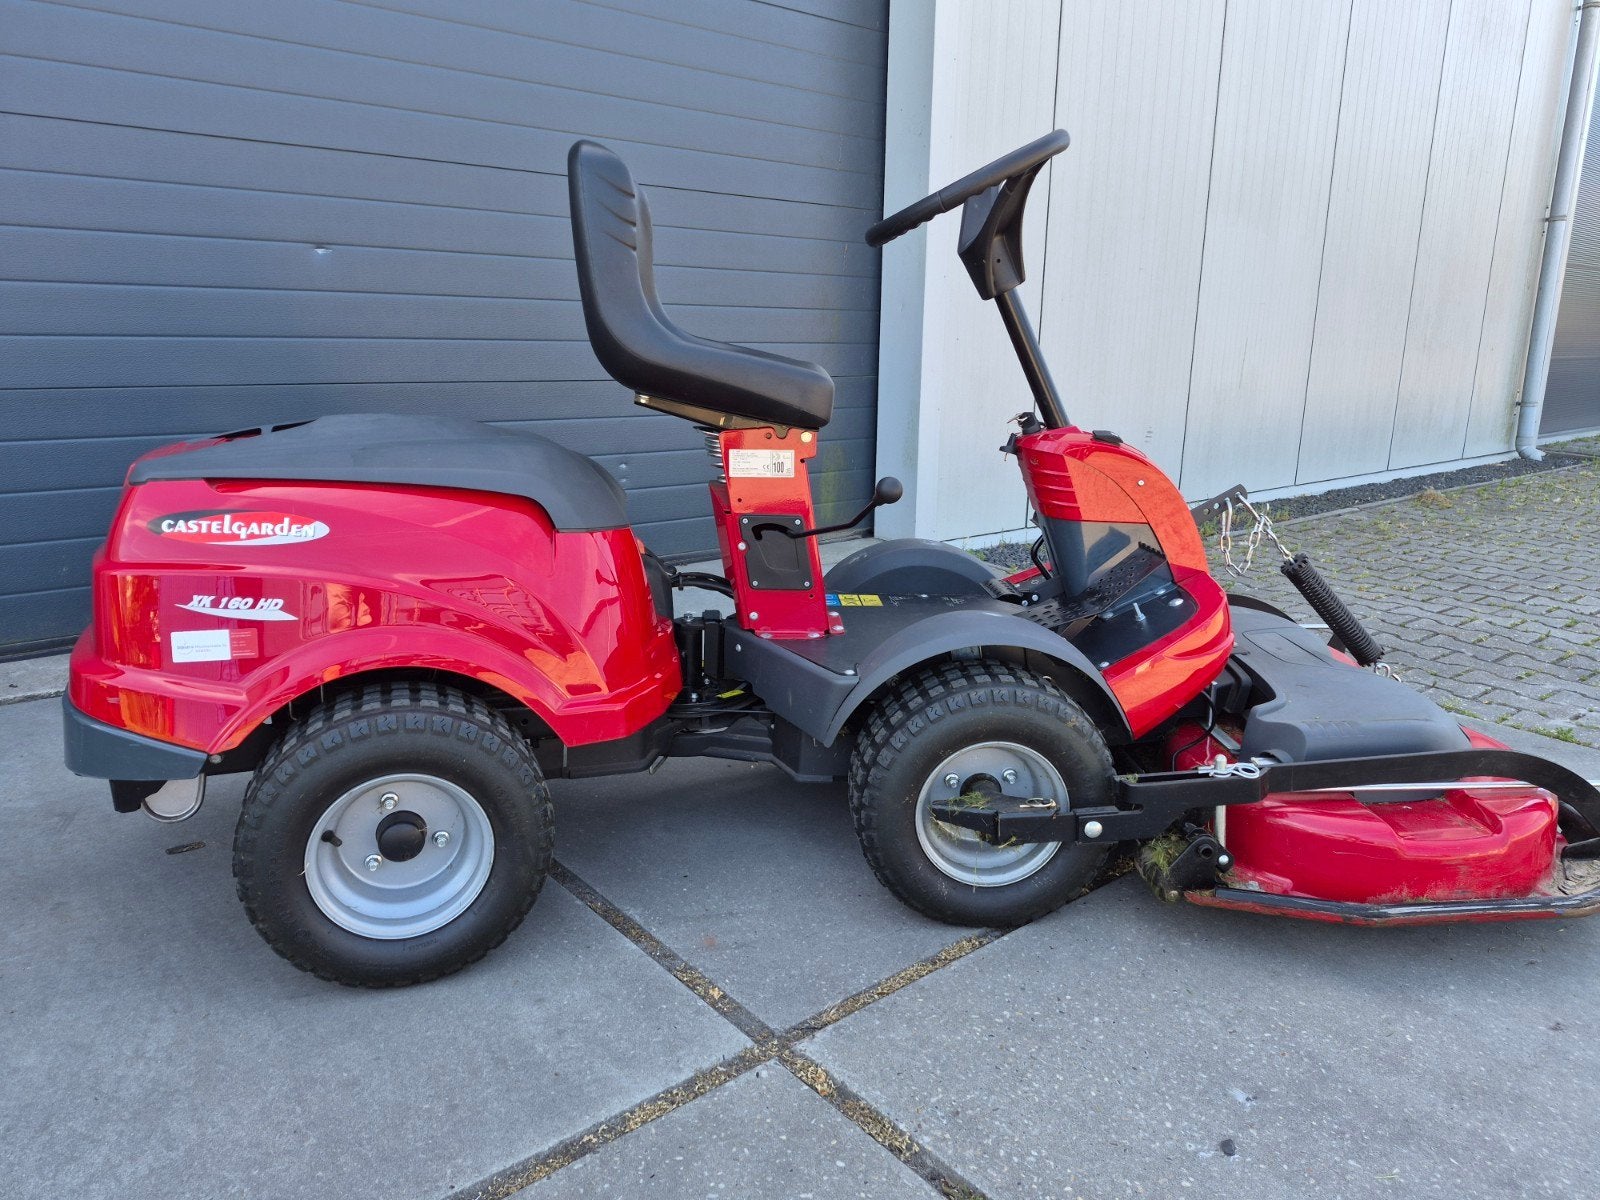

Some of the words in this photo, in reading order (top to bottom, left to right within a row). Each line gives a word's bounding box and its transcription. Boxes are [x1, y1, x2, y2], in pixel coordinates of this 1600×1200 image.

[773, 461, 785, 473] 100
[186, 594, 215, 606] XK
[218, 596, 254, 608] 160
[255, 598, 284, 609] HD
